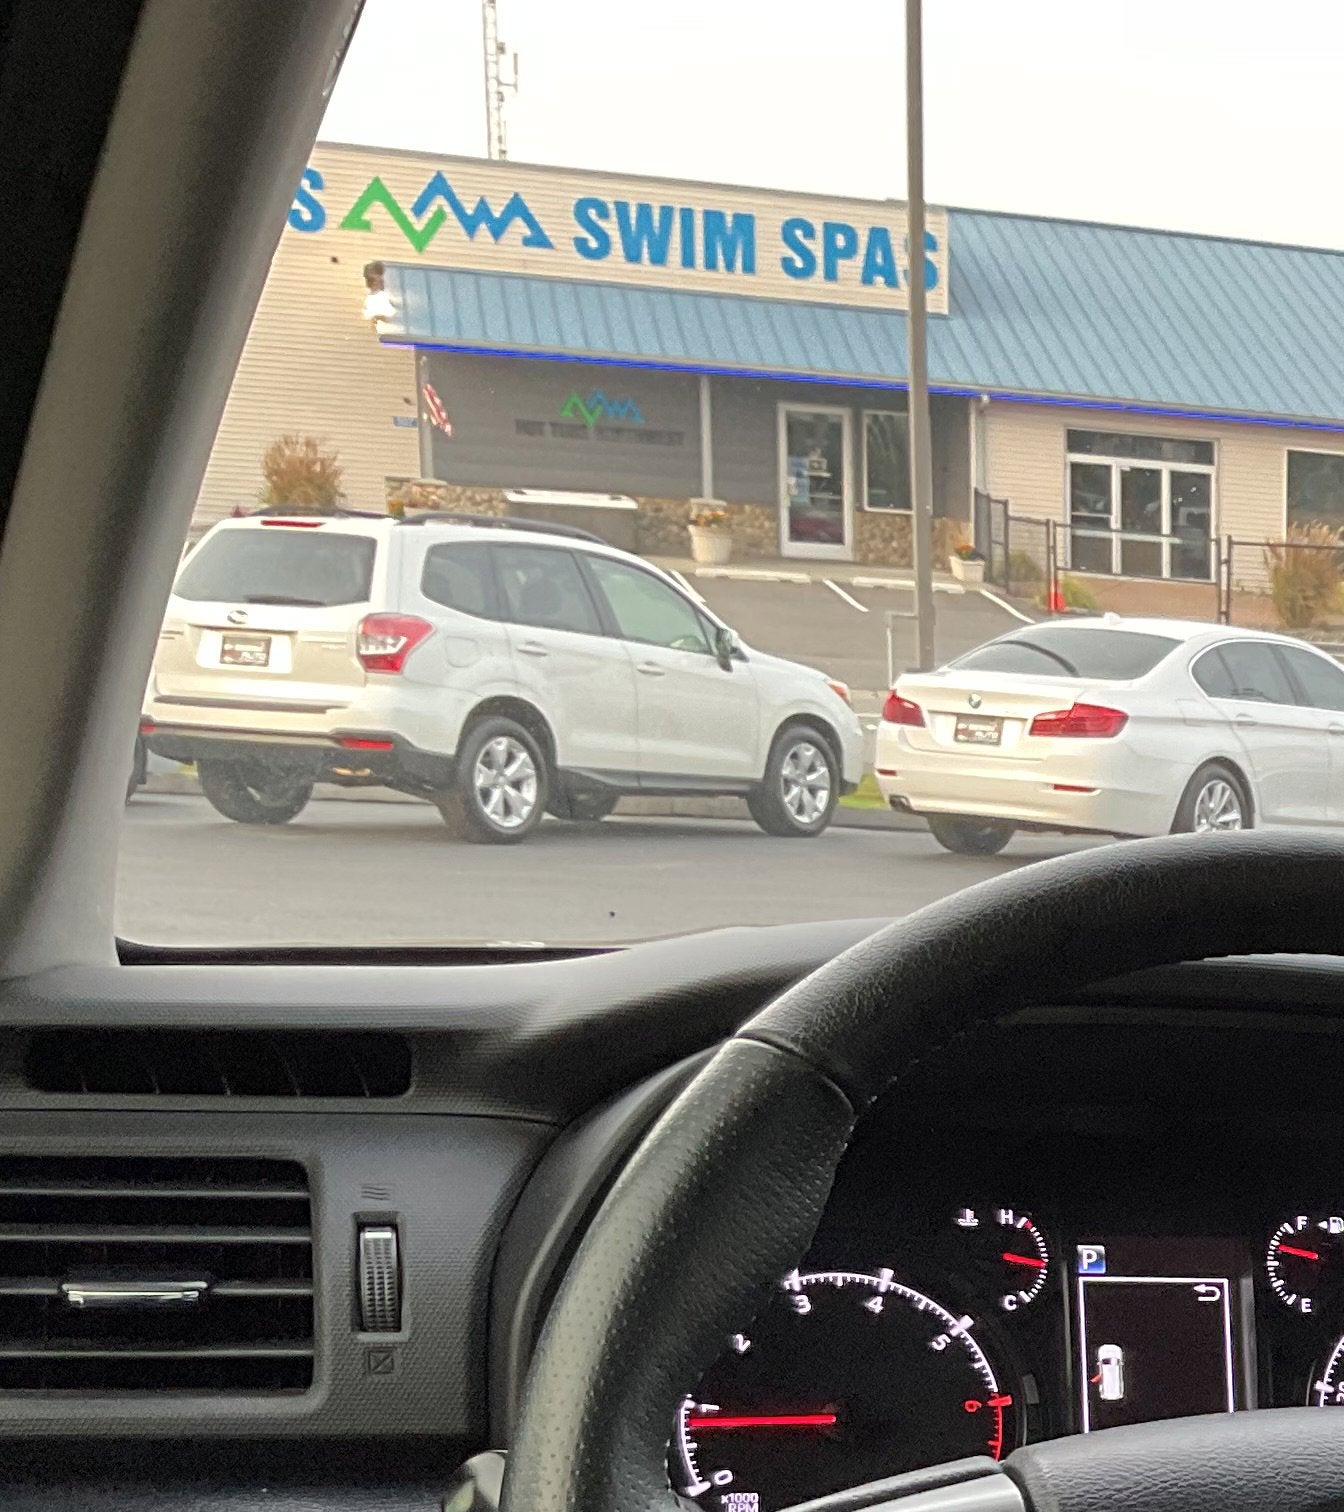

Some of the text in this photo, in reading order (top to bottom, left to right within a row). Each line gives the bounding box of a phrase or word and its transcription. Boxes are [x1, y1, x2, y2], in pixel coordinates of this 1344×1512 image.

[572, 196, 757, 275] SWIM
[1000, 1209, 1014, 1225] H
[1296, 1215, 1308, 1230] F
[1081, 1249, 1098, 1270] P
[796, 1295, 812, 1314] 3
[866, 1296, 885, 1314] 4
[1003, 1295, 1017, 1311] C
[1300, 1298, 1312, 1313] E
[931, 1333, 951, 1351] 5
[964, 1400, 983, 1413] 6
[713, 1469, 734, 1486] 0
[721, 1492, 759, 1504] x1000
